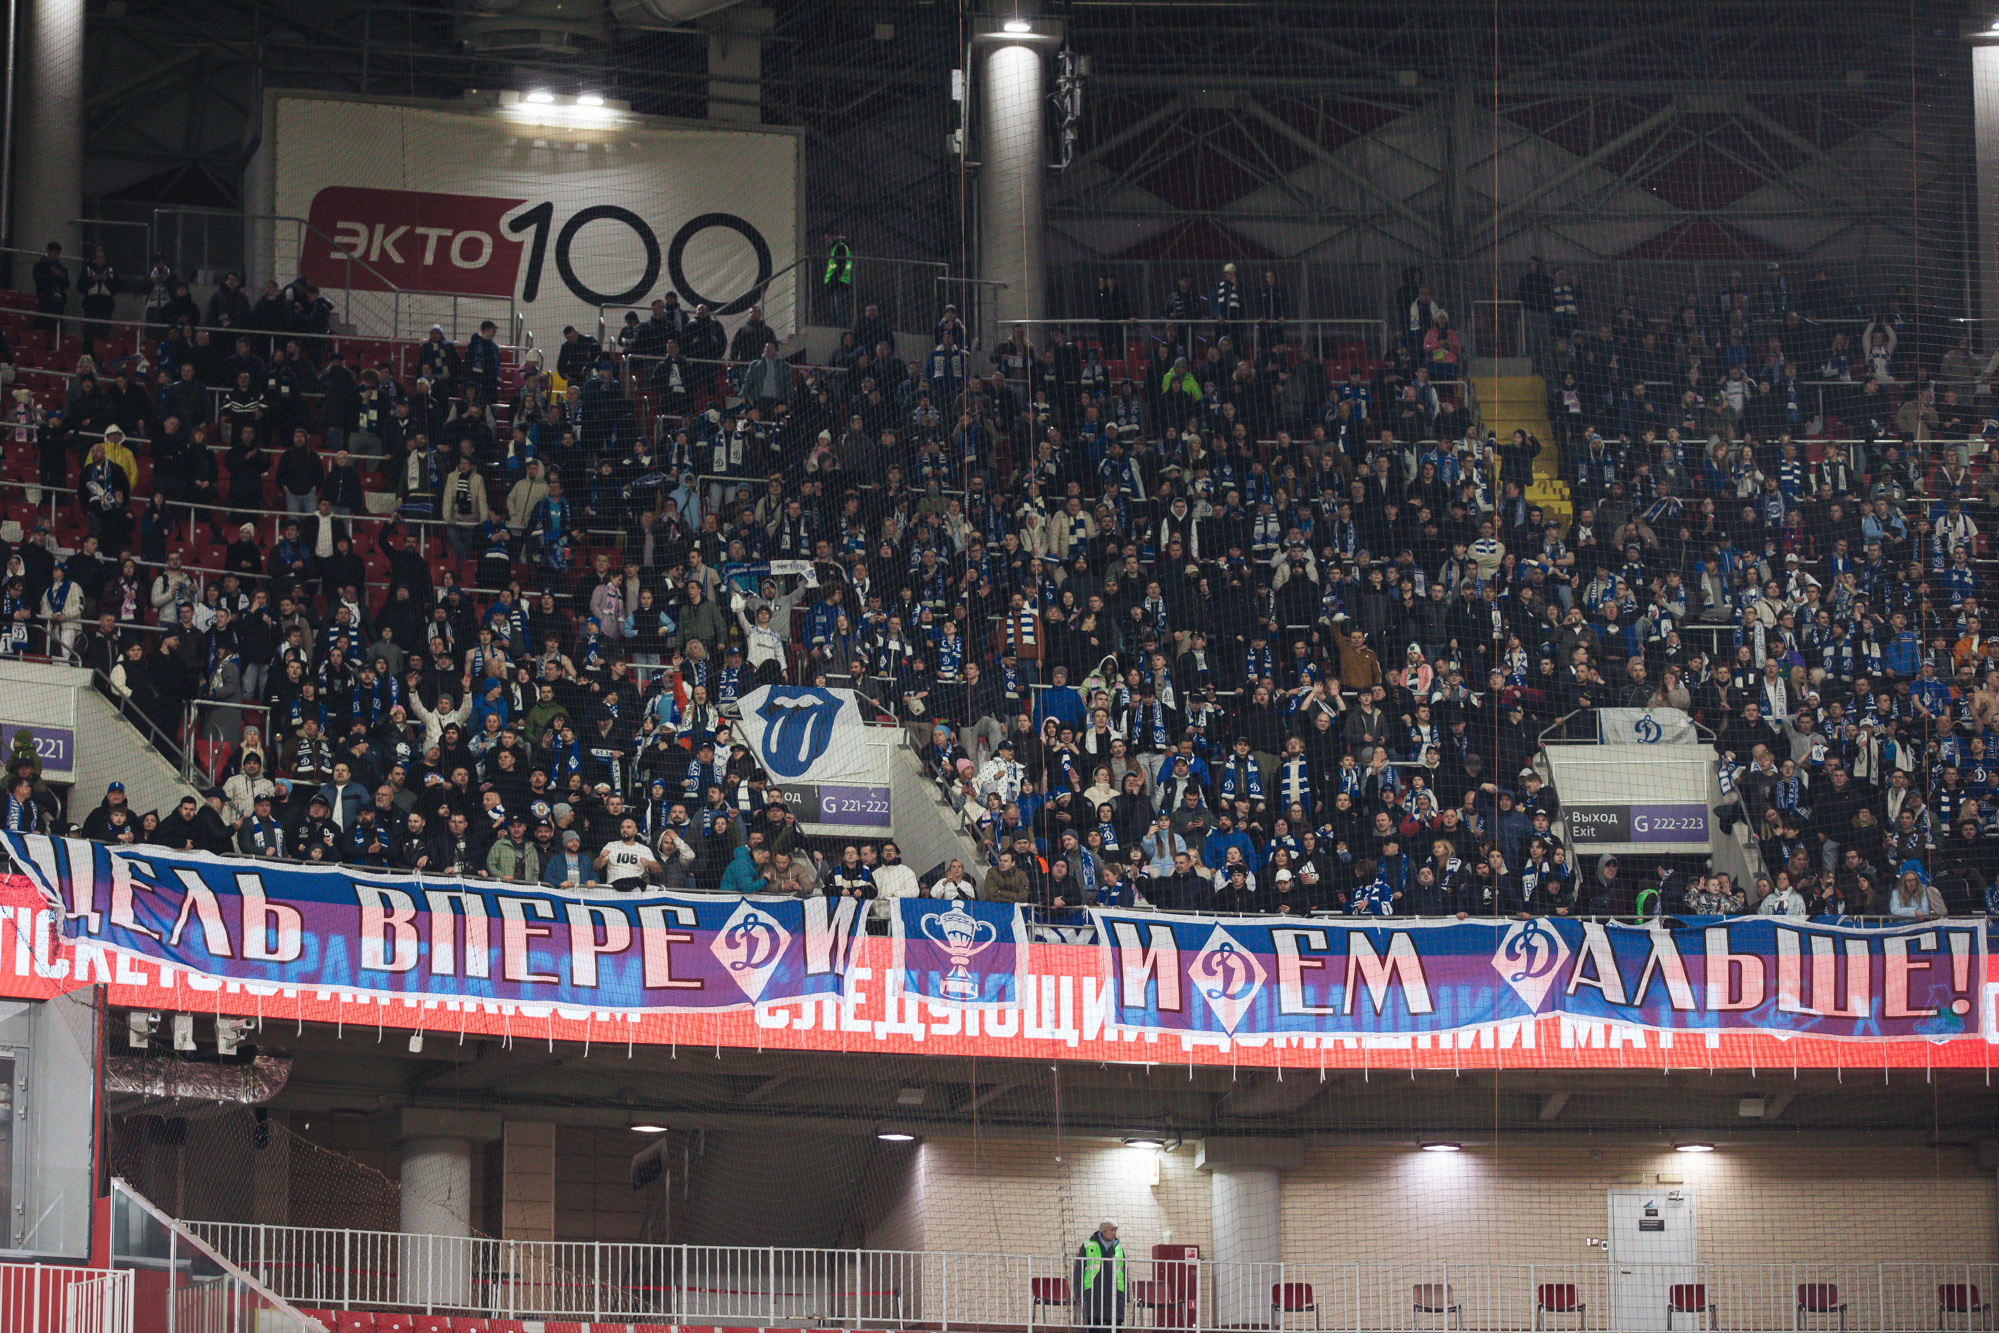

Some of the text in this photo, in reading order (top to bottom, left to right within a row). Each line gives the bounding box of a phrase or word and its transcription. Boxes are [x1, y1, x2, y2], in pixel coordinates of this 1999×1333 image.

[329, 201, 773, 316] ЭКТО 100
[33, 737, 64, 759] 221
[822, 796, 889, 813] G 221-222
[1572, 811, 1618, 825] Выход
[1634, 815, 1704, 833] G 222-223
[1572, 826, 1596, 837] Exit
[616, 853, 638, 865] 106
[24, 834, 304, 963] ЦЕЛЬ
